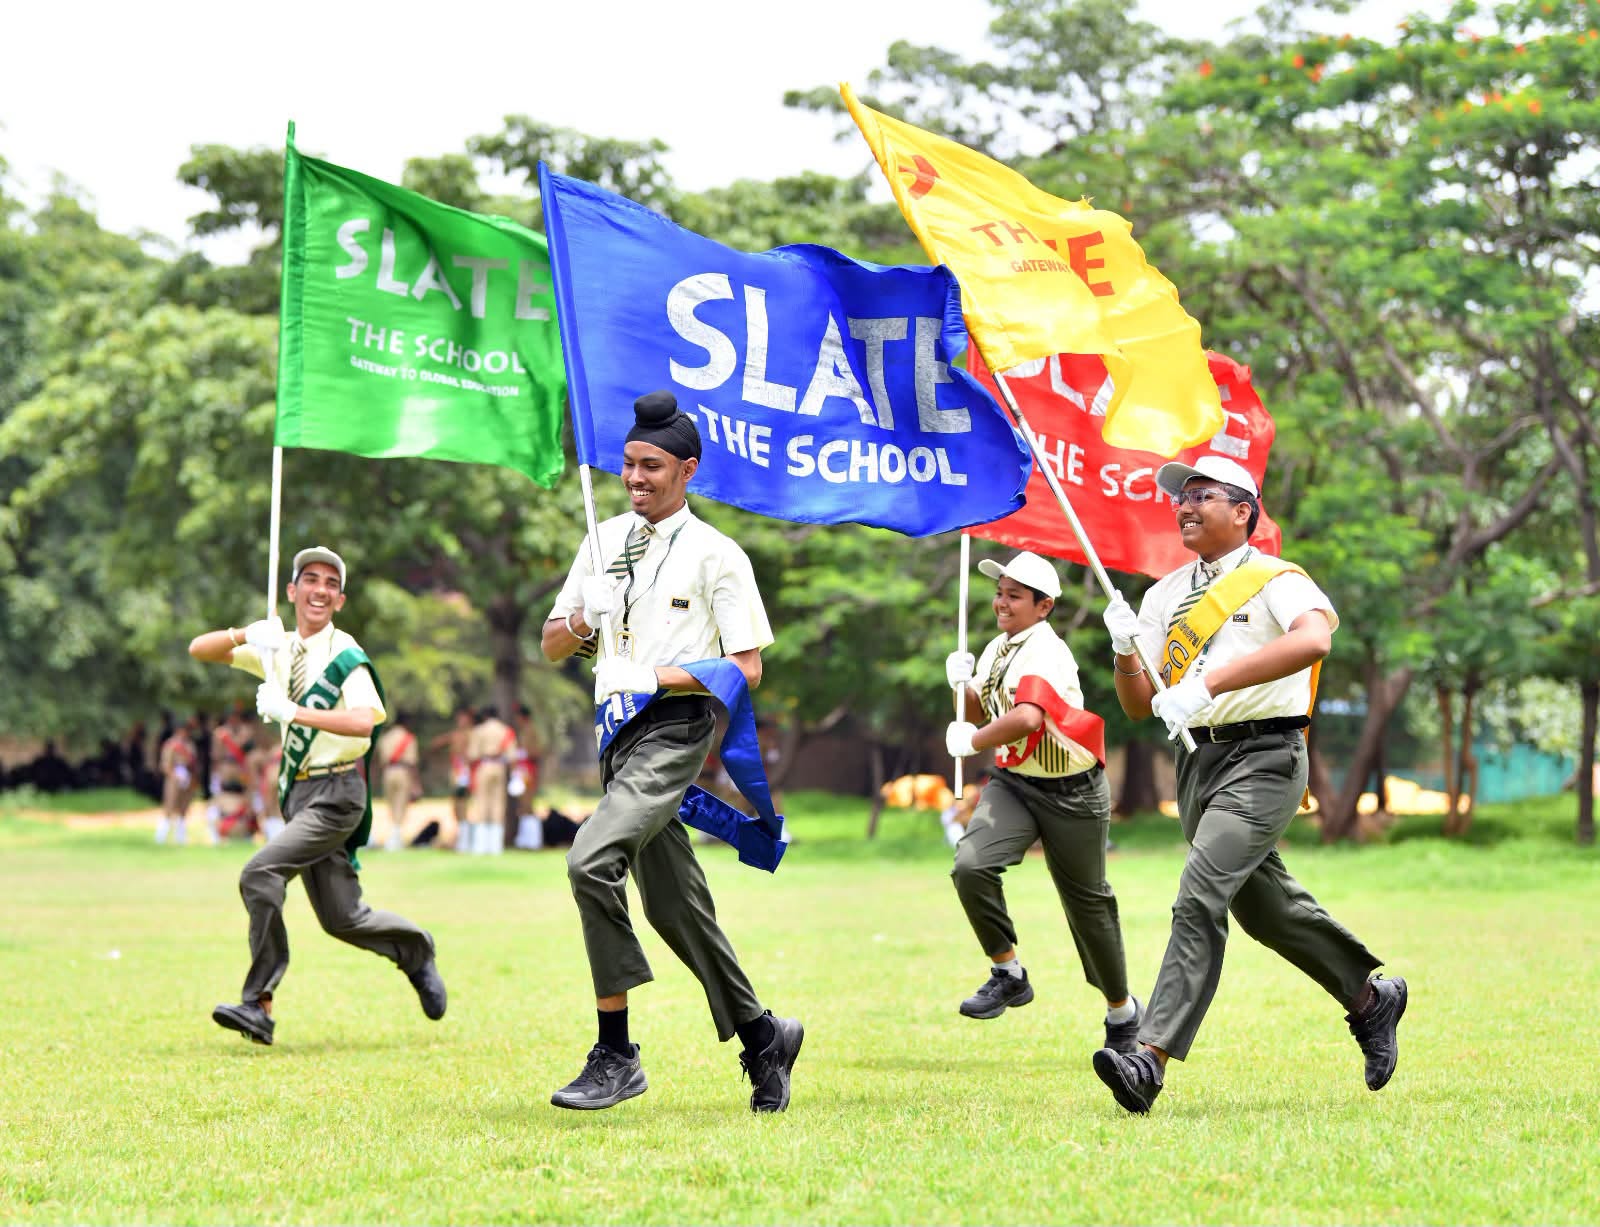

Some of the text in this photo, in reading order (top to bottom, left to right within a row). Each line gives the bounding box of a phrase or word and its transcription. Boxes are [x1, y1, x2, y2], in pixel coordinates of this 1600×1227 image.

[335, 219, 550, 321] SLATE
[347, 317, 526, 374] THE SCHOOL
[350, 355, 399, 377] GATEWAY
[401, 368, 418, 381] TO
[420, 369, 460, 388] GLOBAL
[666, 272, 972, 434] SLATE
[697, 403, 968, 486] THE SCHOOL
